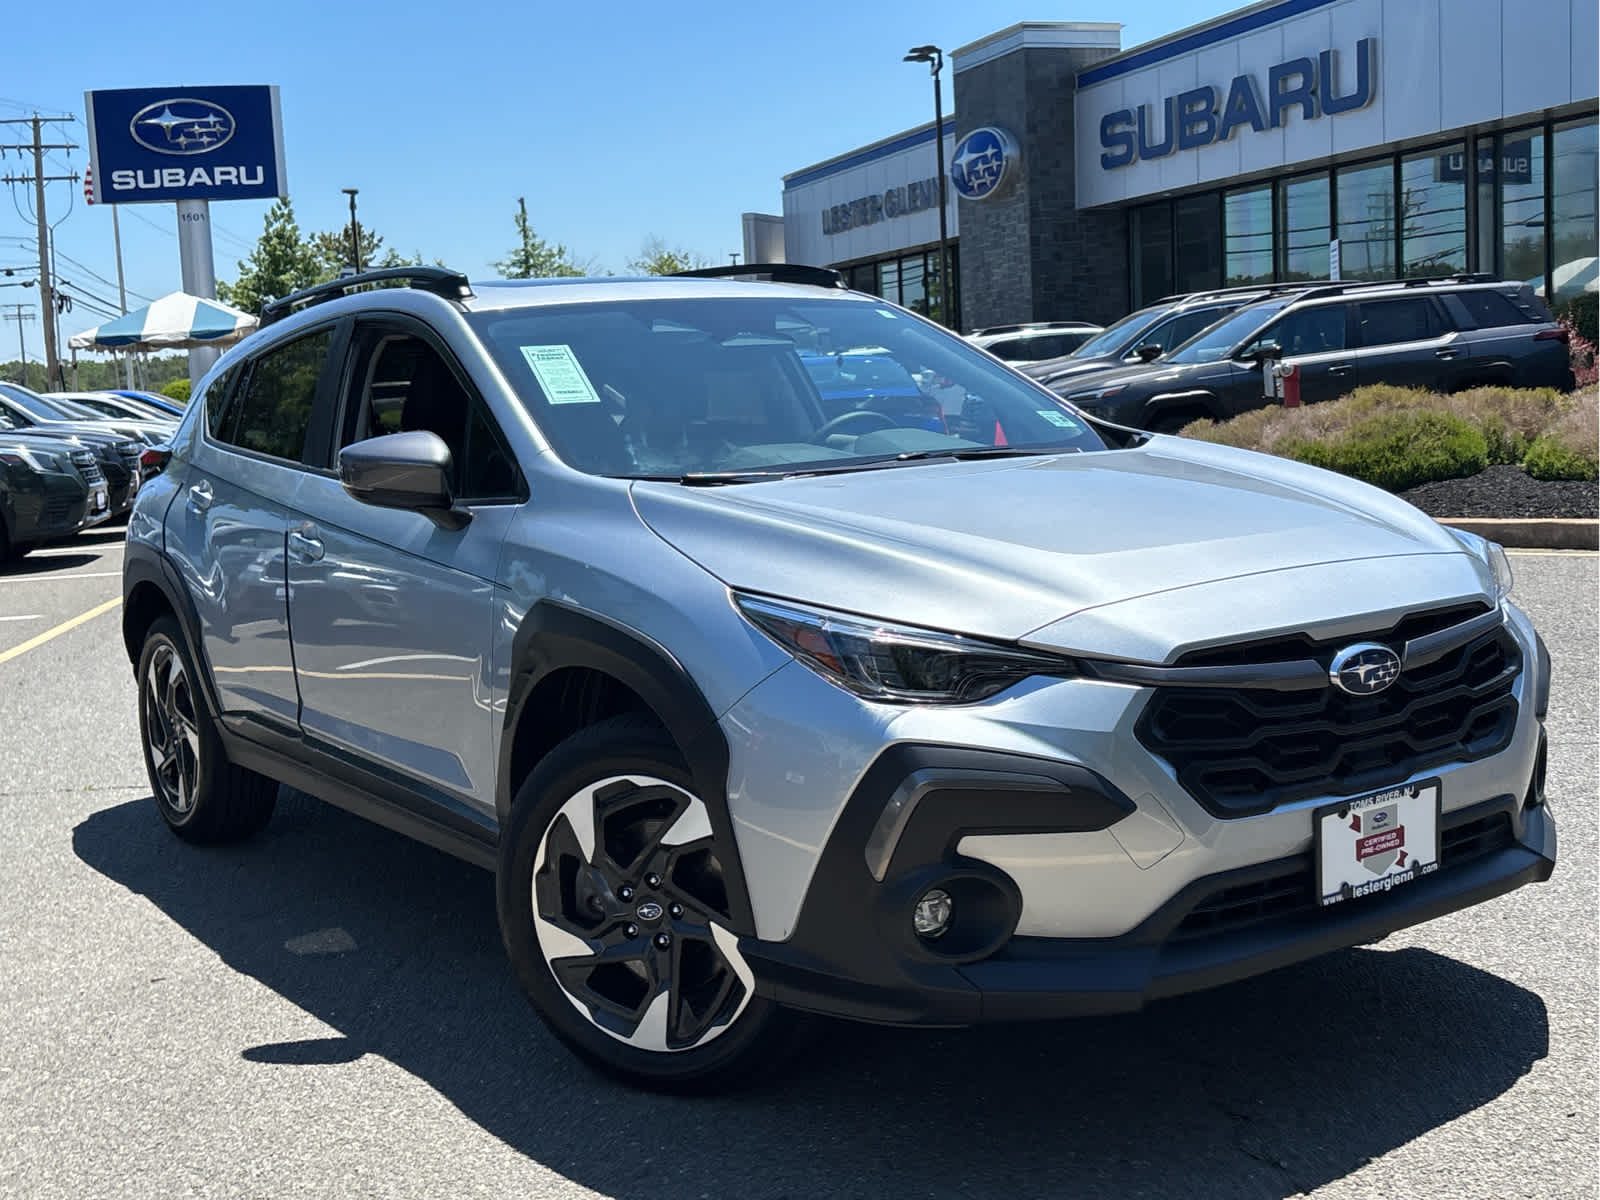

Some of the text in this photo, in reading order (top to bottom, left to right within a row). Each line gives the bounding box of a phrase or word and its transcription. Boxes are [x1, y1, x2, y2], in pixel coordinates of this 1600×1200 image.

[1100, 37, 1377, 171] SUBARU
[111, 165, 264, 190] SUBARU
[181, 213, 205, 222] 1501
[822, 194, 885, 235] LESTER
[1350, 796, 1374, 810] TOMS
[1404, 784, 1416, 797] NJ
[1361, 839, 1400, 856] PRE-OWNED
[1363, 832, 1397, 847] CERTIFIED
[1352, 871, 1414, 899] lesterglenn
